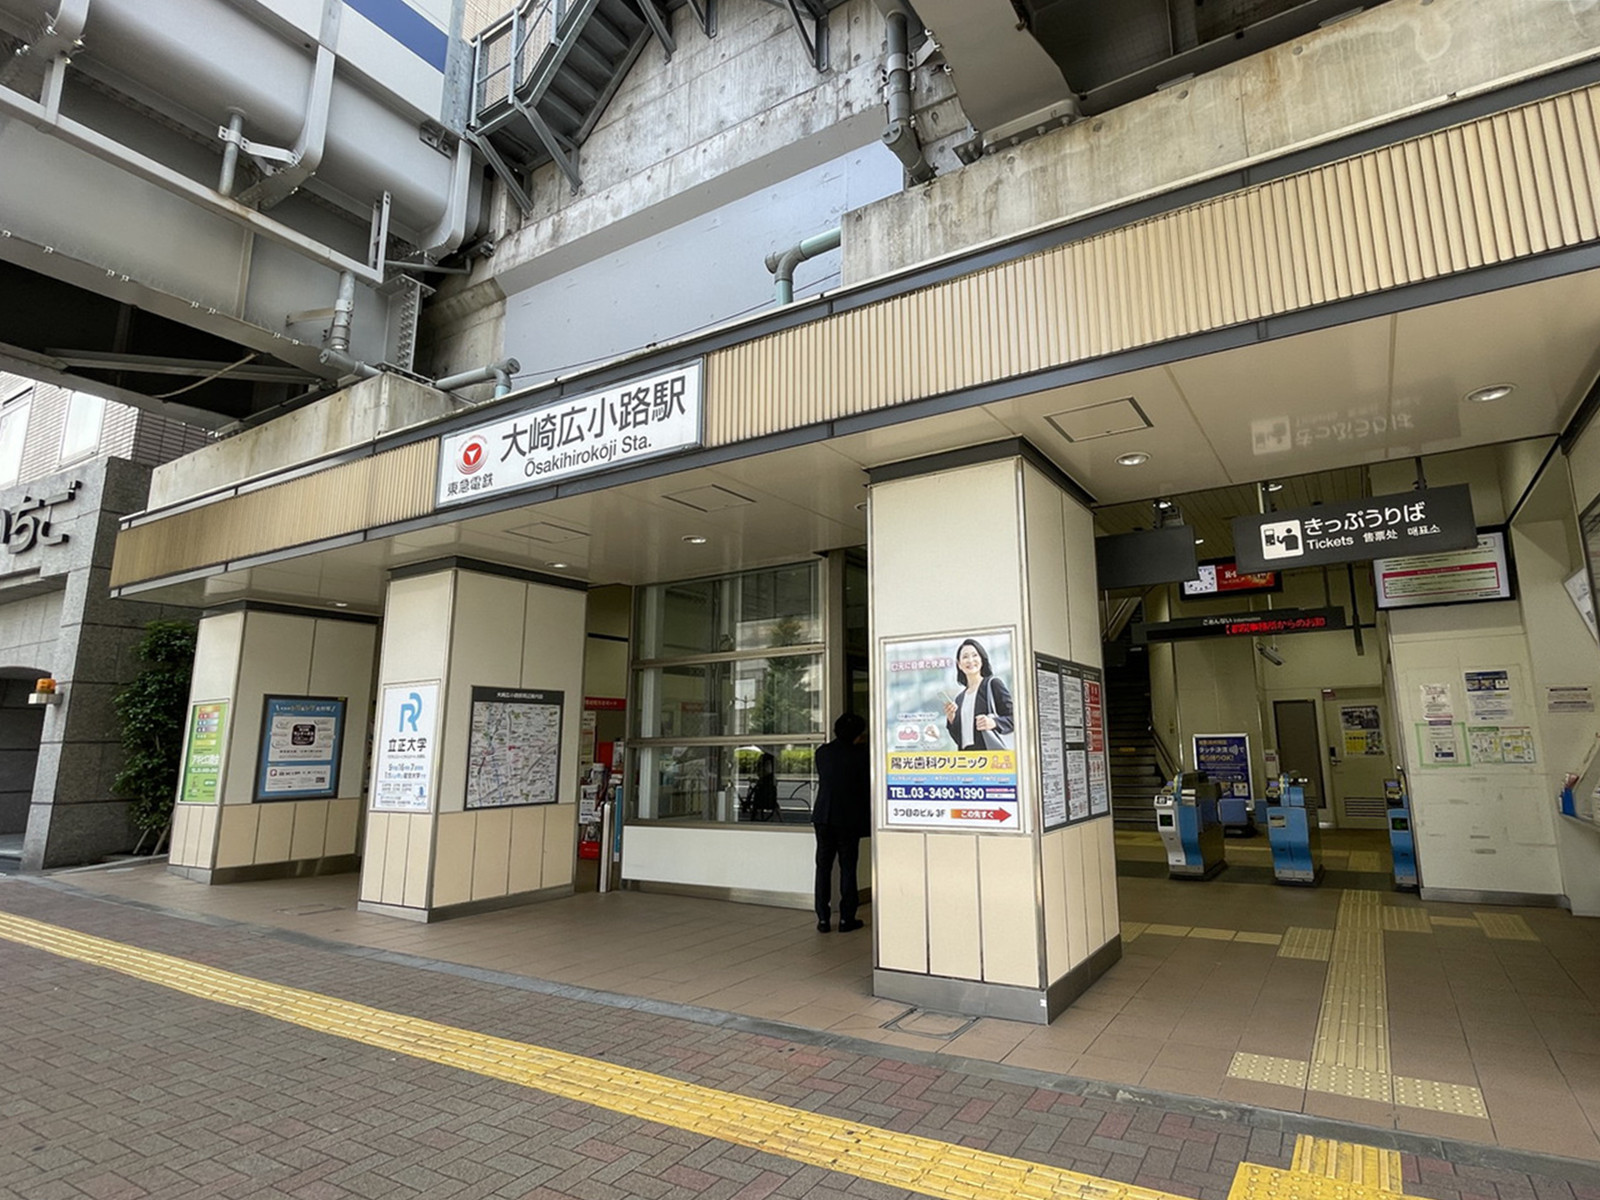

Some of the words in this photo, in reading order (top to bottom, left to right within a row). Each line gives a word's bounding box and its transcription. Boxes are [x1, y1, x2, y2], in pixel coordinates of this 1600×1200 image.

[500, 374, 686, 463] 大崎広小路駅
[524, 439, 617, 478] Ōsakihirokōji
[621, 434, 652, 454] Sta.
[447, 473, 494, 497] 東急電鉄
[1303, 501, 1426, 535] きっぷうりば
[1306, 536, 1354, 551] Tickets
[1407, 524, 1441, 537] 매표소
[387, 738, 428, 753] 立正大学
[890, 756, 988, 770] 陽光歯科クリニック
[890, 787, 985, 800] TEL.03-3490-1390
[935, 808, 946, 818] 3F
[960, 809, 995, 819] この先すぐ
